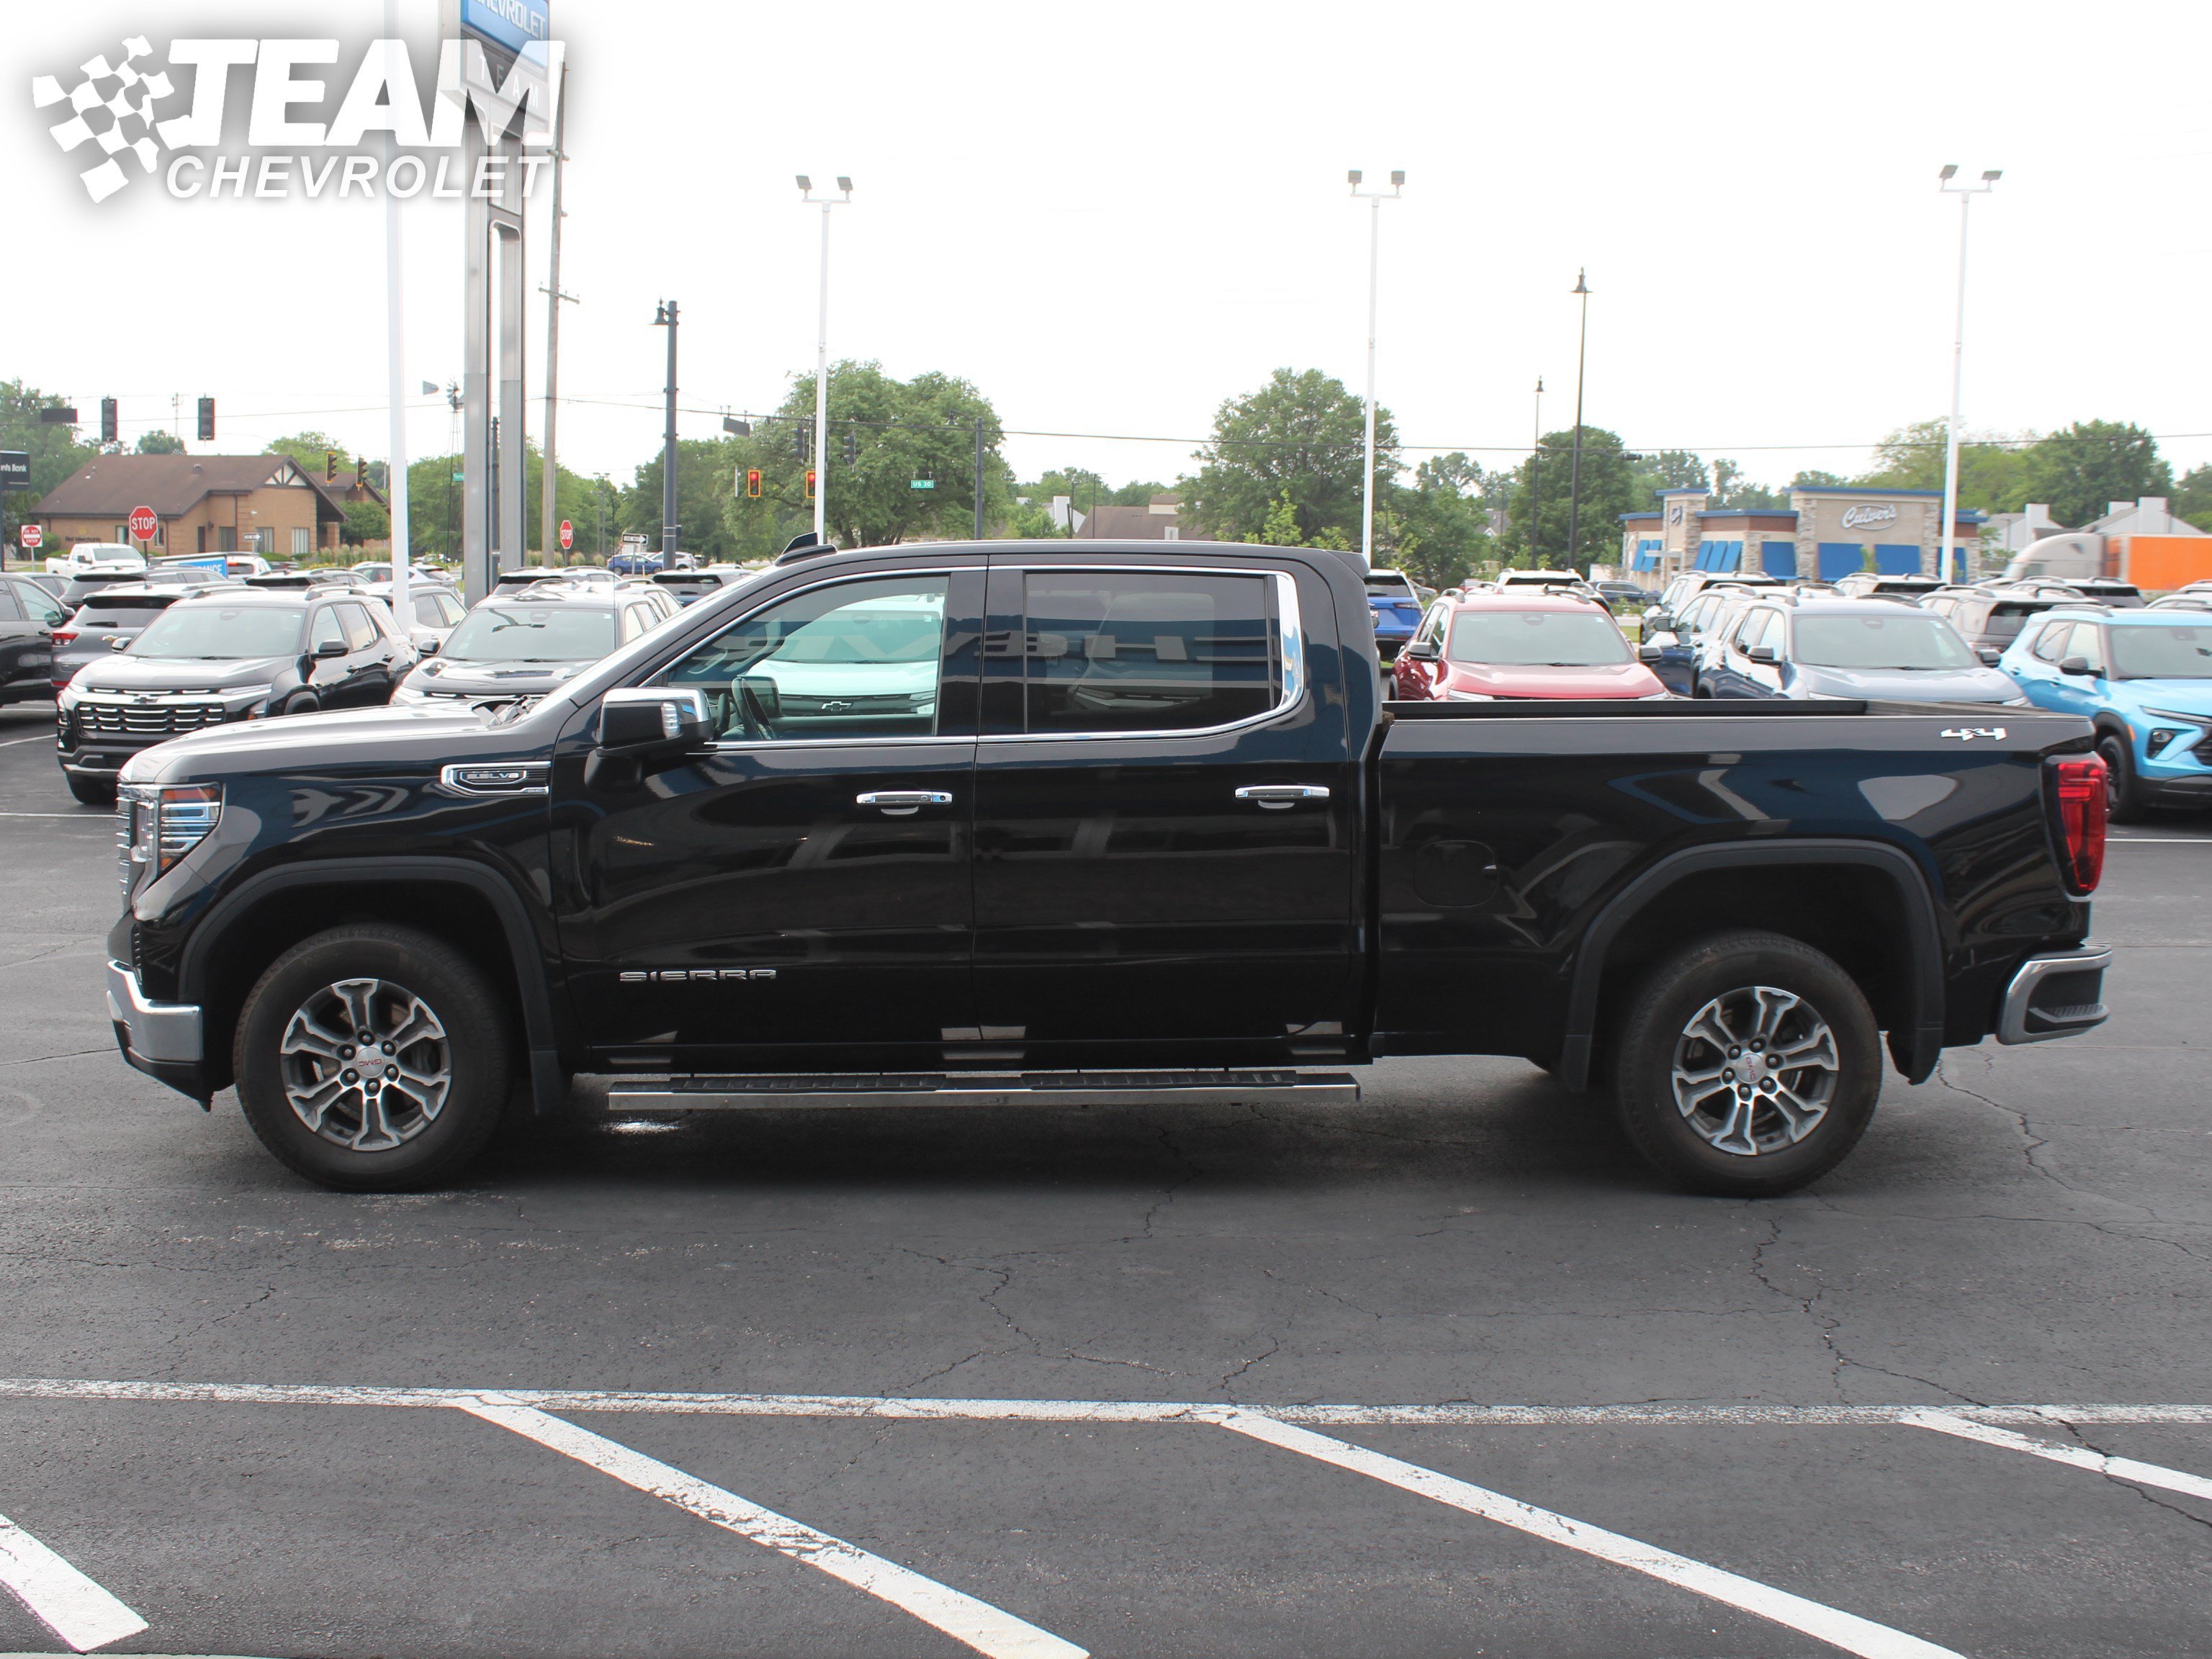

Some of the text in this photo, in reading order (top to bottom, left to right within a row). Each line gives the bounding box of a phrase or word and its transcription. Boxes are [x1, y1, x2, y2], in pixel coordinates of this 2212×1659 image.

[12, 464, 27, 472] Bank
[132, 517, 156, 531] STOP
[561, 529, 572, 540] STOP
[620, 969, 776, 981] SIERRA
[358, 1058, 382, 1067] GMC
[1745, 1056, 1757, 1080] GMC
